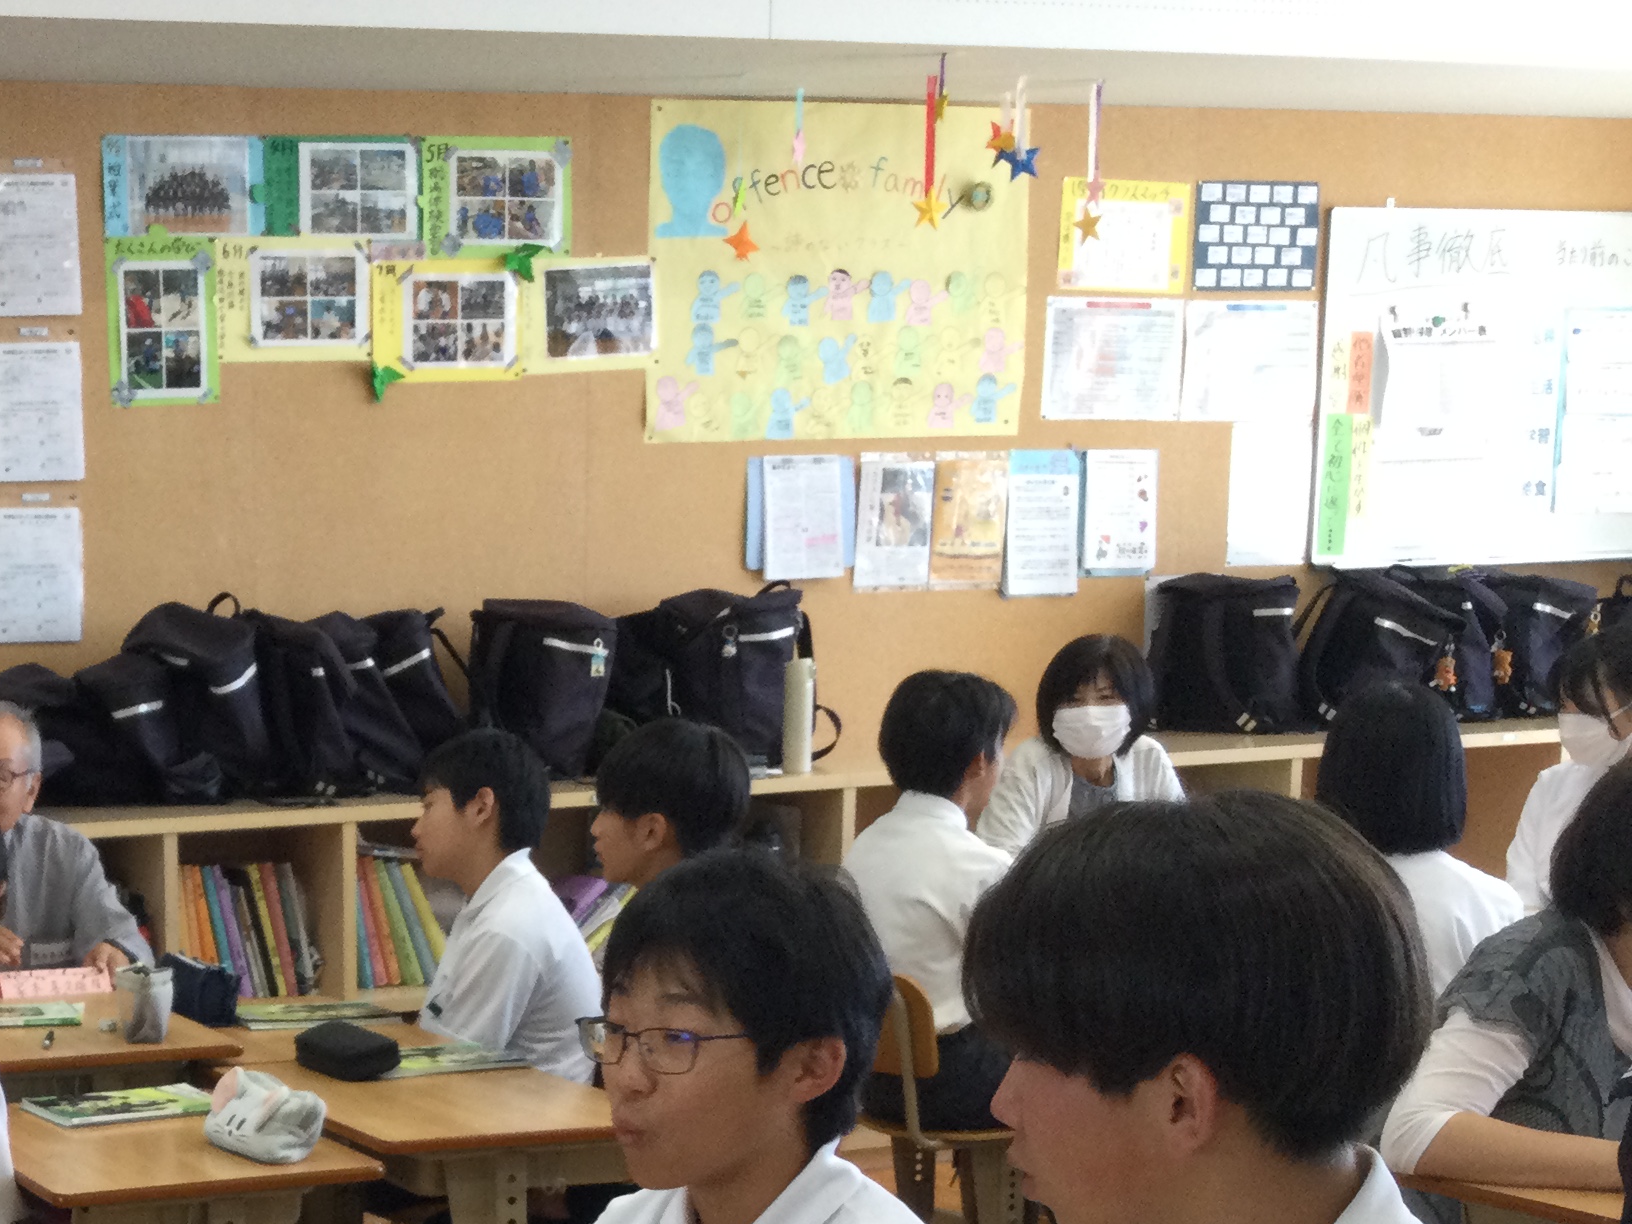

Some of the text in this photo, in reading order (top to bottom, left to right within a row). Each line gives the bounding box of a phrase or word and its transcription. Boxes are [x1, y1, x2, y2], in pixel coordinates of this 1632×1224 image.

[870, 156, 968, 220] famly
[1357, 225, 1511, 284] 凡事徹底
